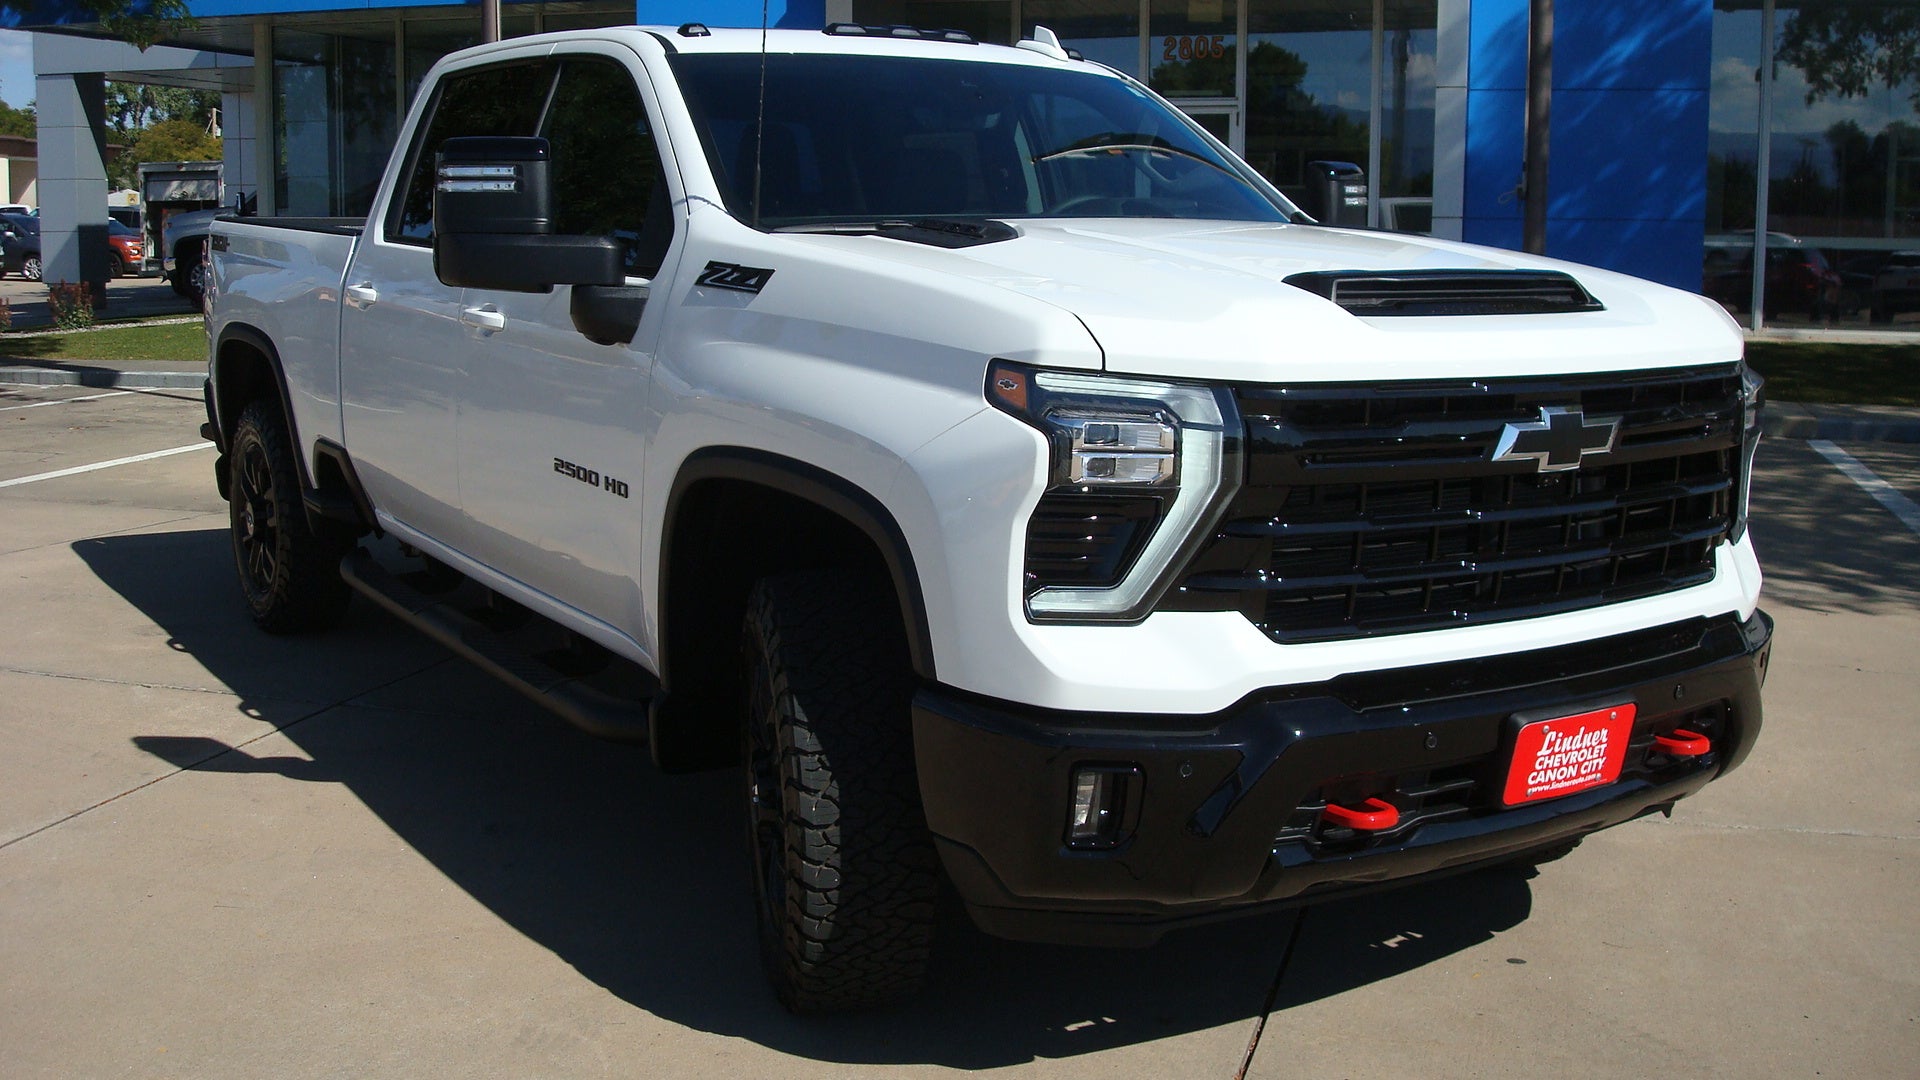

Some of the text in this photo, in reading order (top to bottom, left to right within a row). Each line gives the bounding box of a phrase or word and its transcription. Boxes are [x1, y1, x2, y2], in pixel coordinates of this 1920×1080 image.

[1164, 35, 1225, 60] 2805
[553, 457, 628, 499] 2500 HD
[1536, 726, 1608, 756] Lindner
[1527, 763, 1578, 785] CANON
[1580, 756, 1607, 775] CITY
[1535, 743, 1607, 770] CHEVROLET
